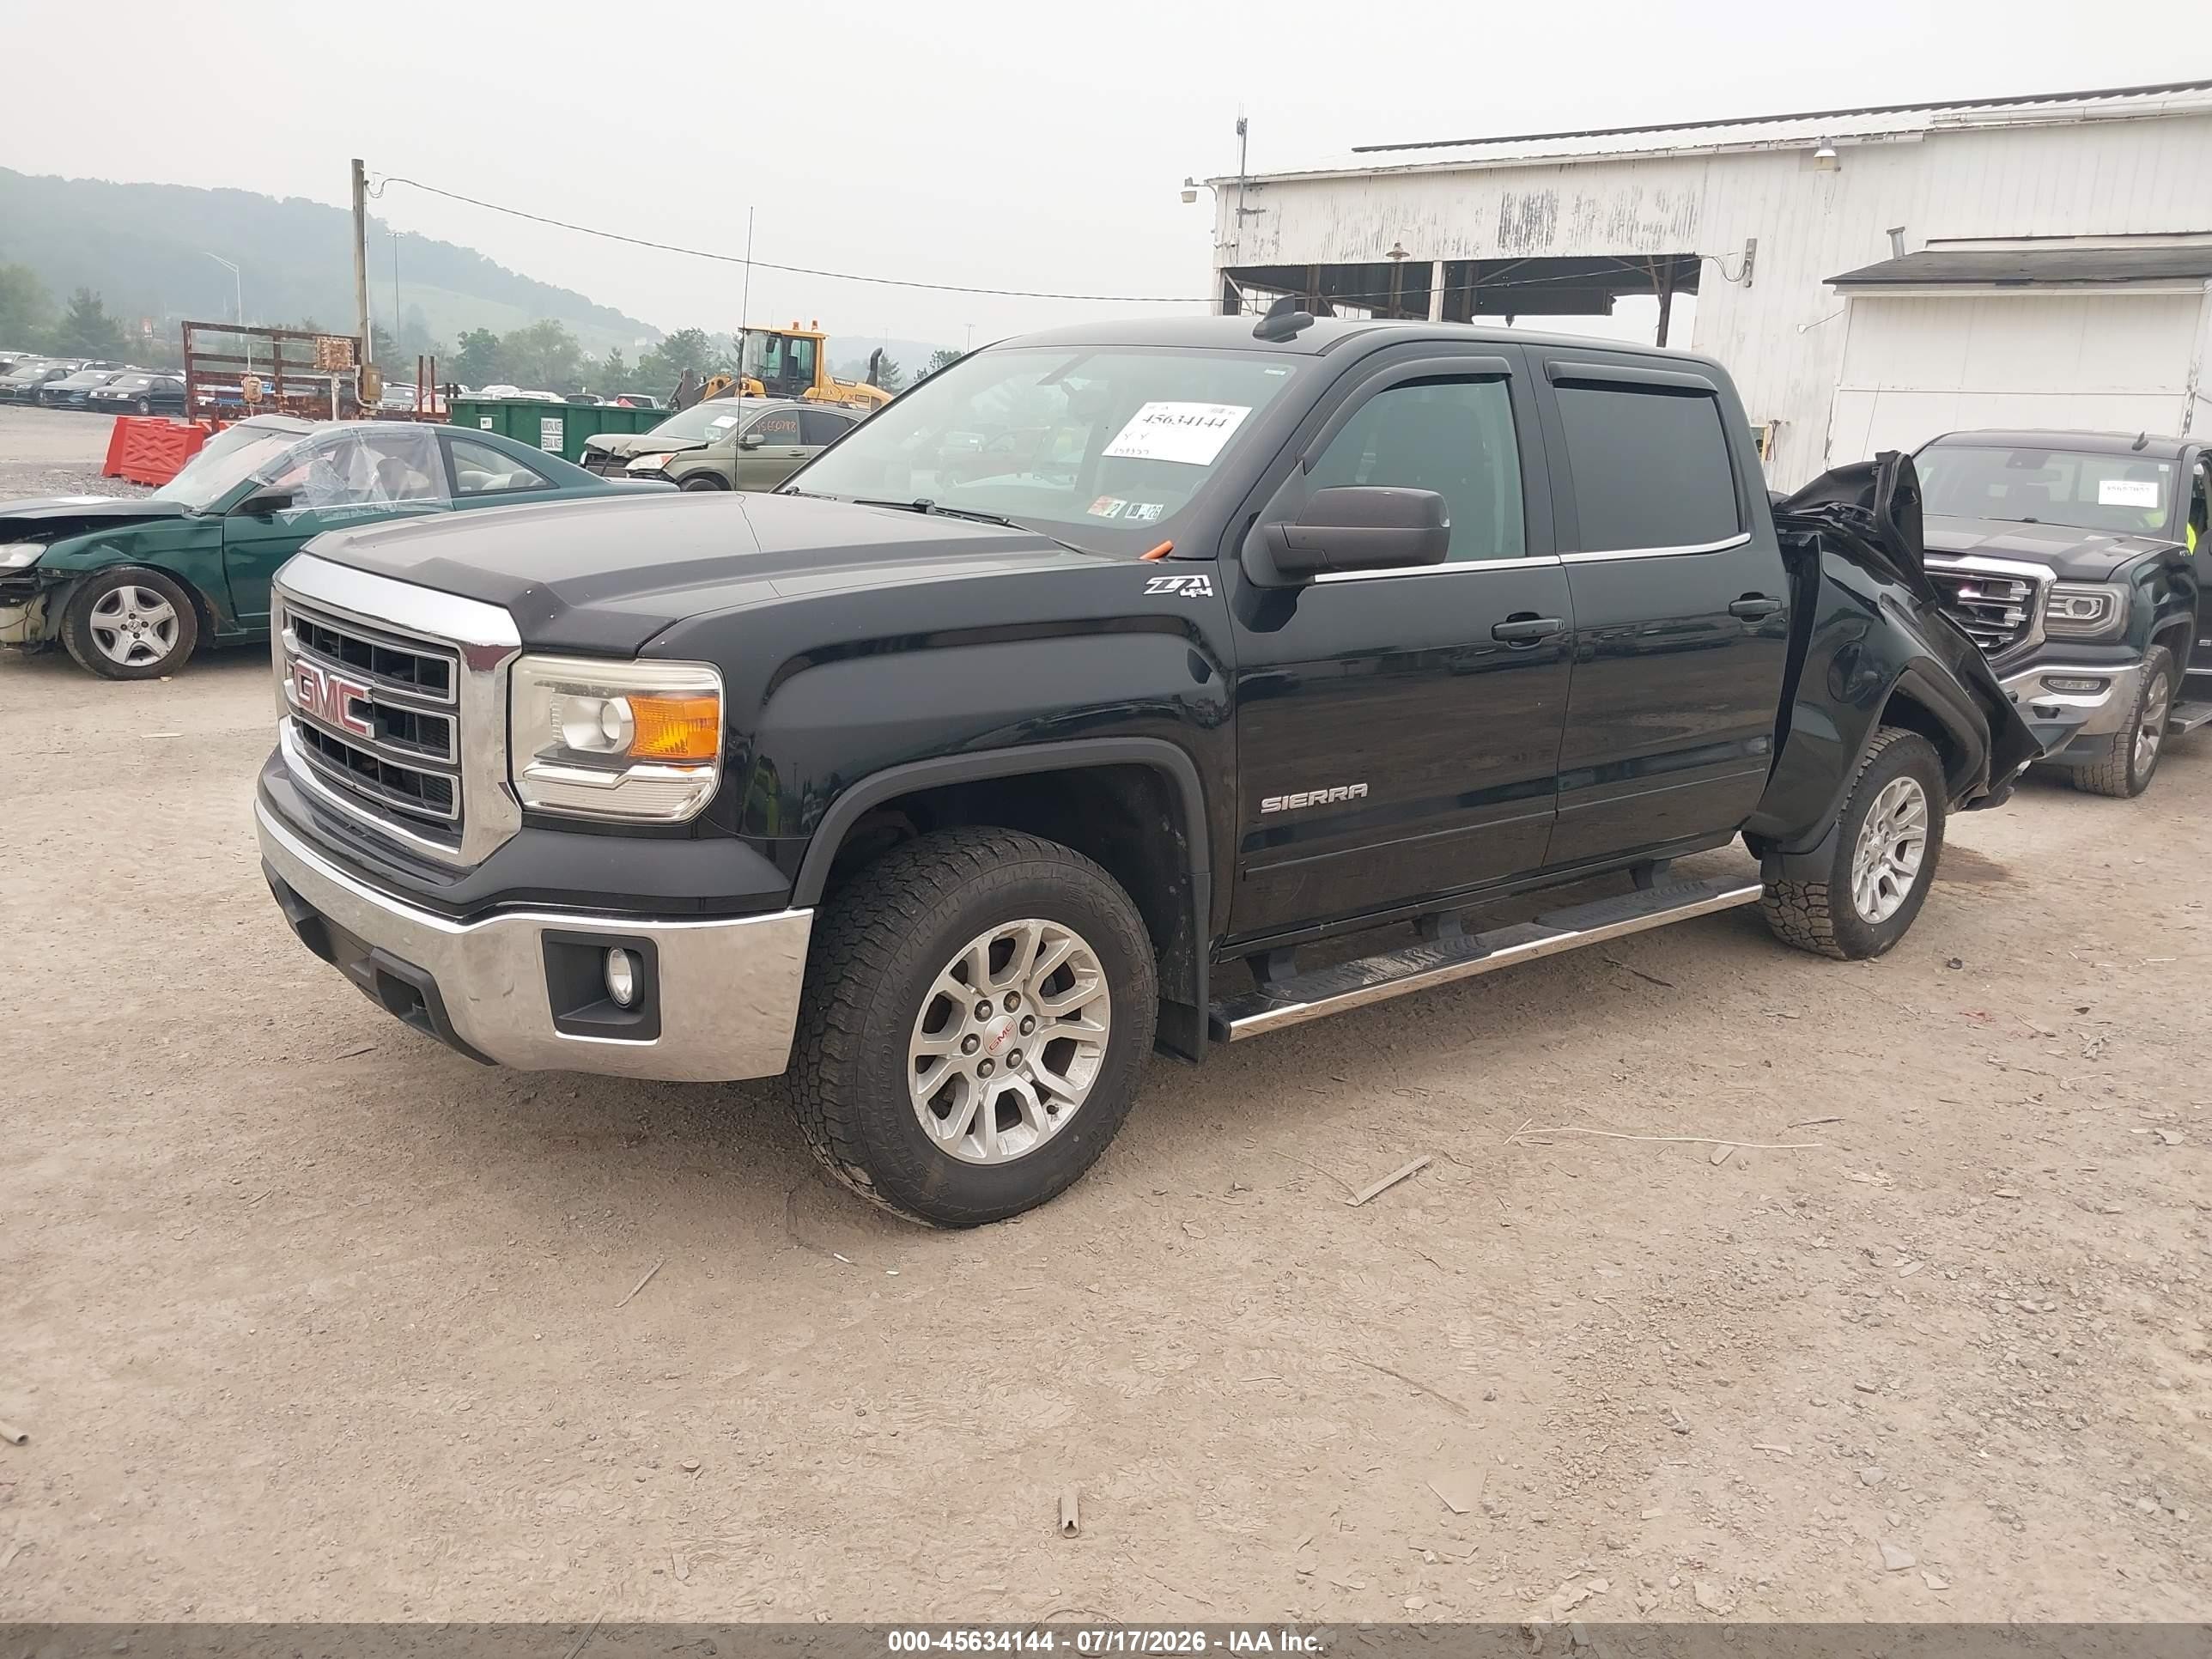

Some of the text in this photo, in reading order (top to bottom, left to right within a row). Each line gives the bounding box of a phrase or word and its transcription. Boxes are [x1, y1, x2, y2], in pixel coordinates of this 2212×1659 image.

[295, 659, 375, 739] GMC
[1261, 782, 1369, 814] SIERRA
[988, 1021, 1014, 1050] GMC
